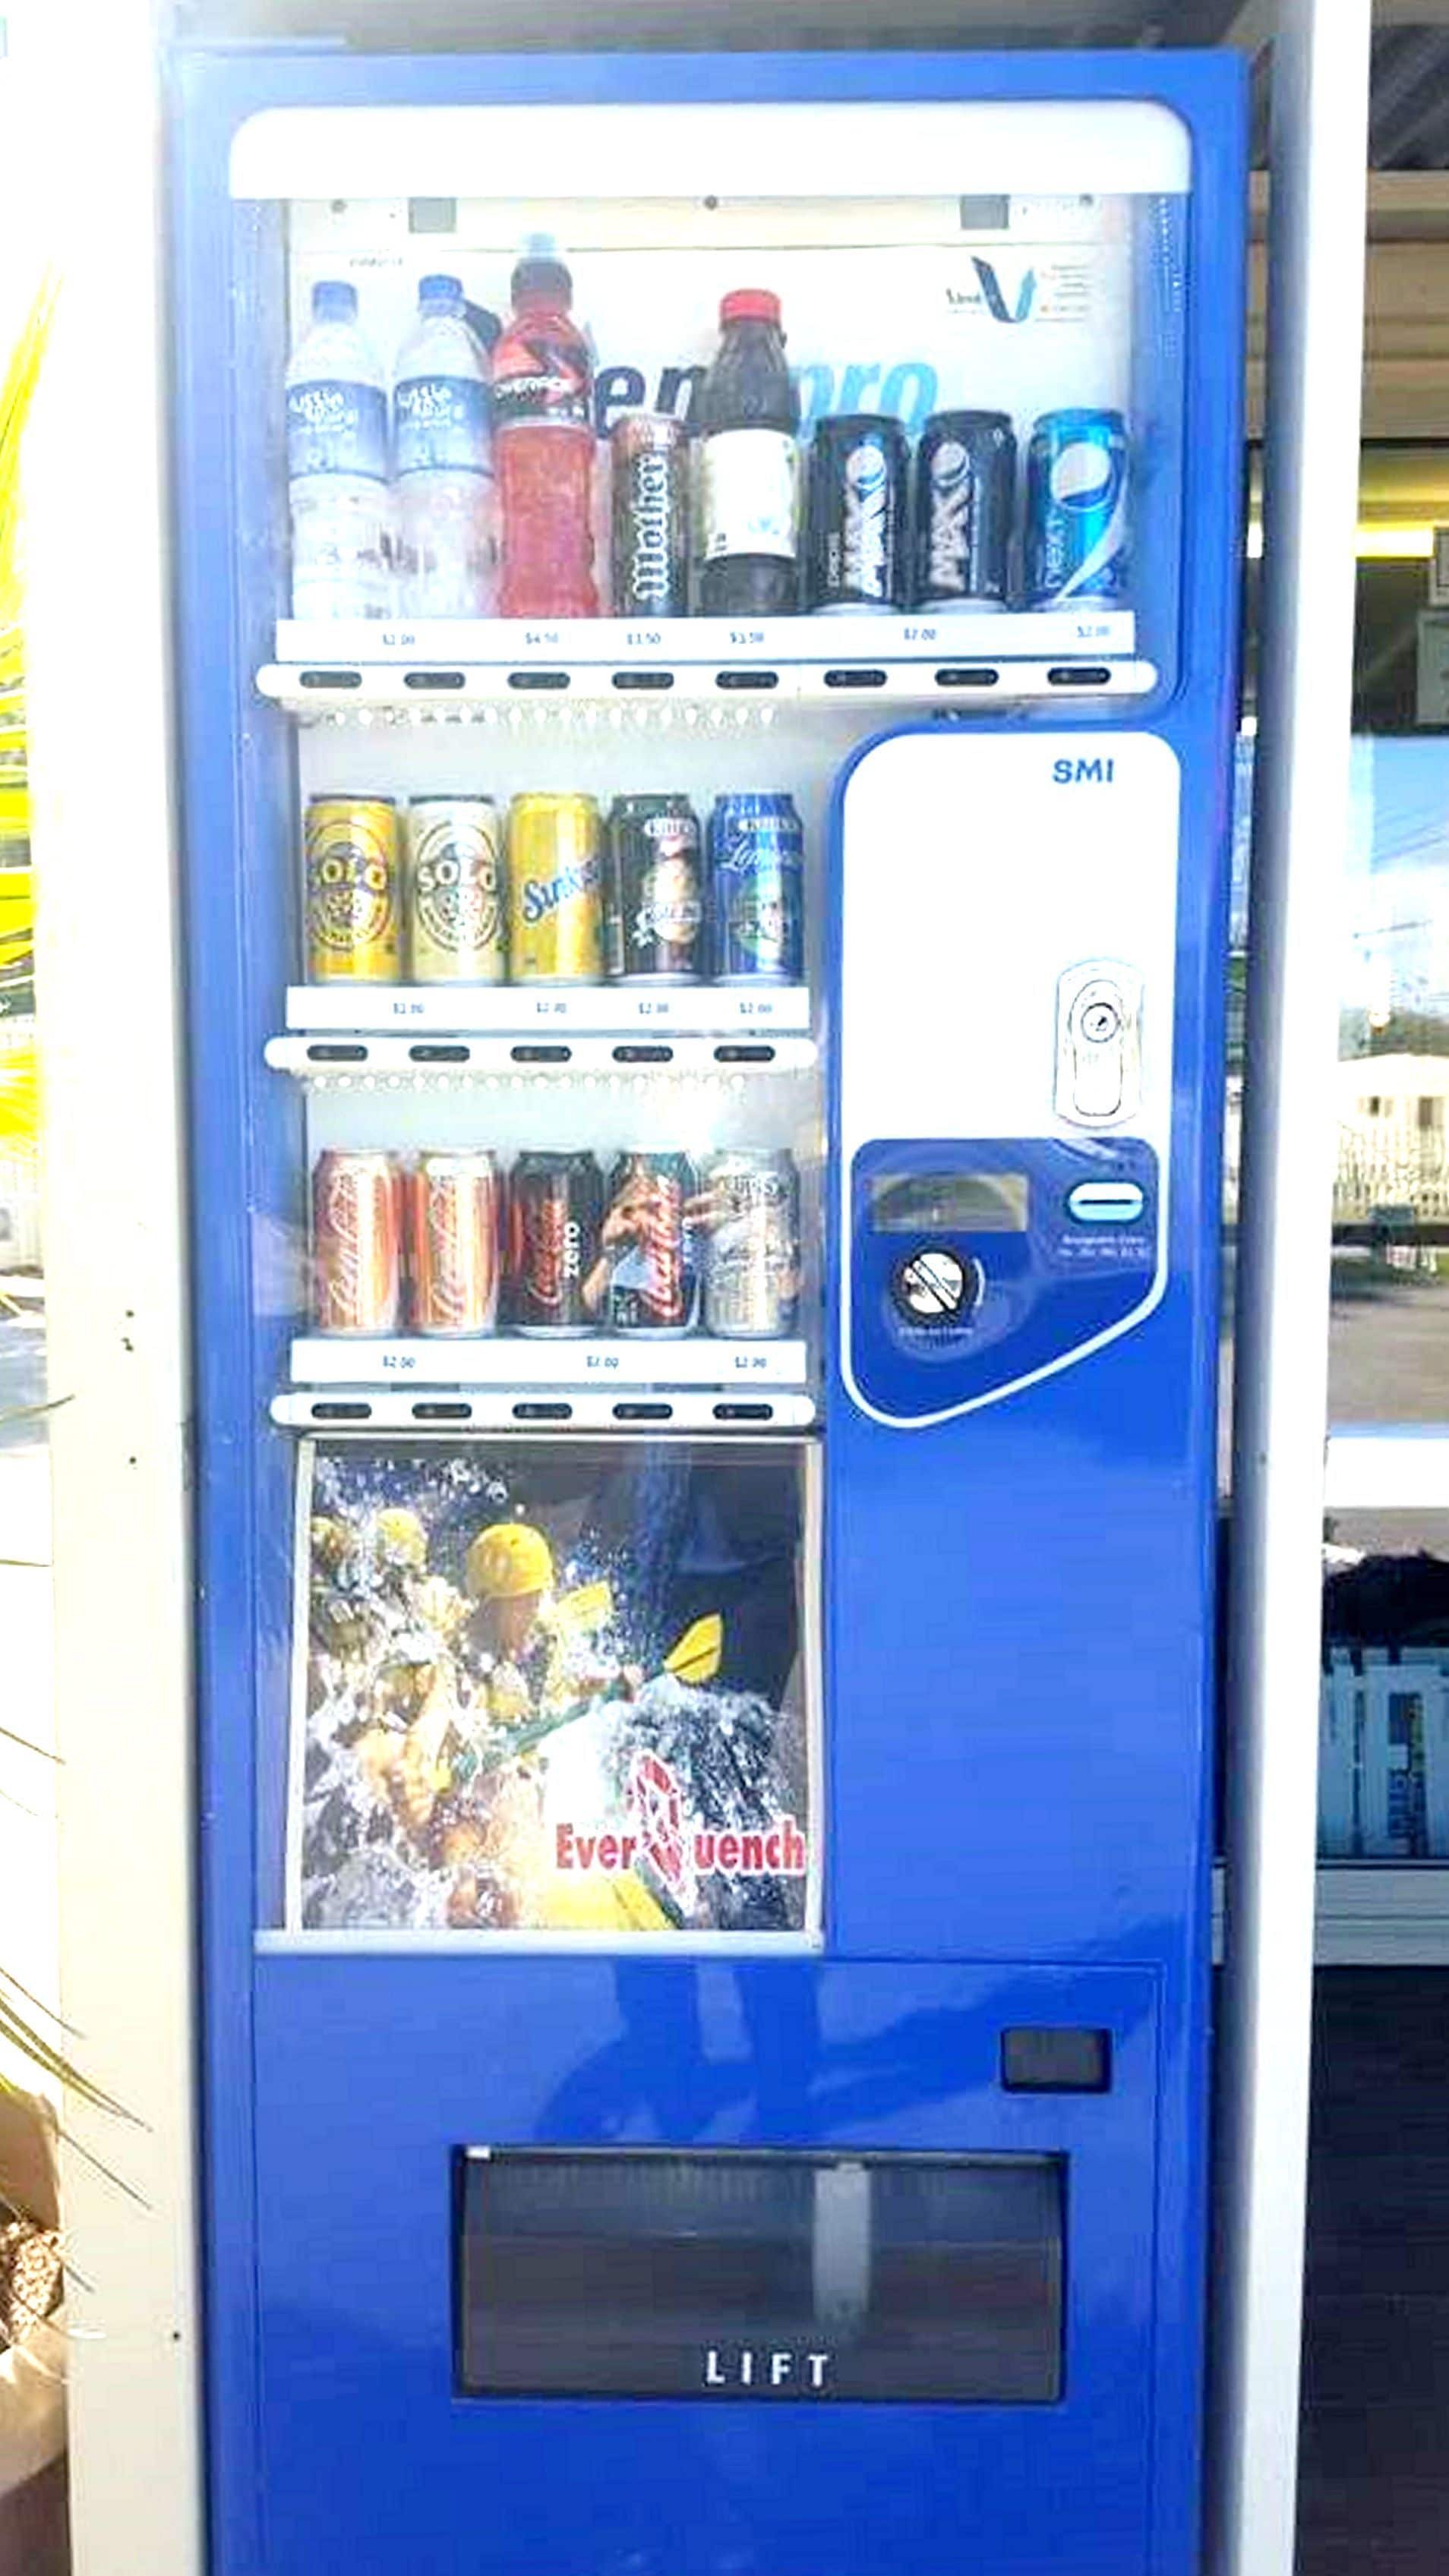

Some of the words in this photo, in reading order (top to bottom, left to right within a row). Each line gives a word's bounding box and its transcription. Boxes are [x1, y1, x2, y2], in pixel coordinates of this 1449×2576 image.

[1052, 757, 1115, 784] SMI
[563, 1221, 580, 1279] zero
[706, 2351, 829, 2388] LIFT
